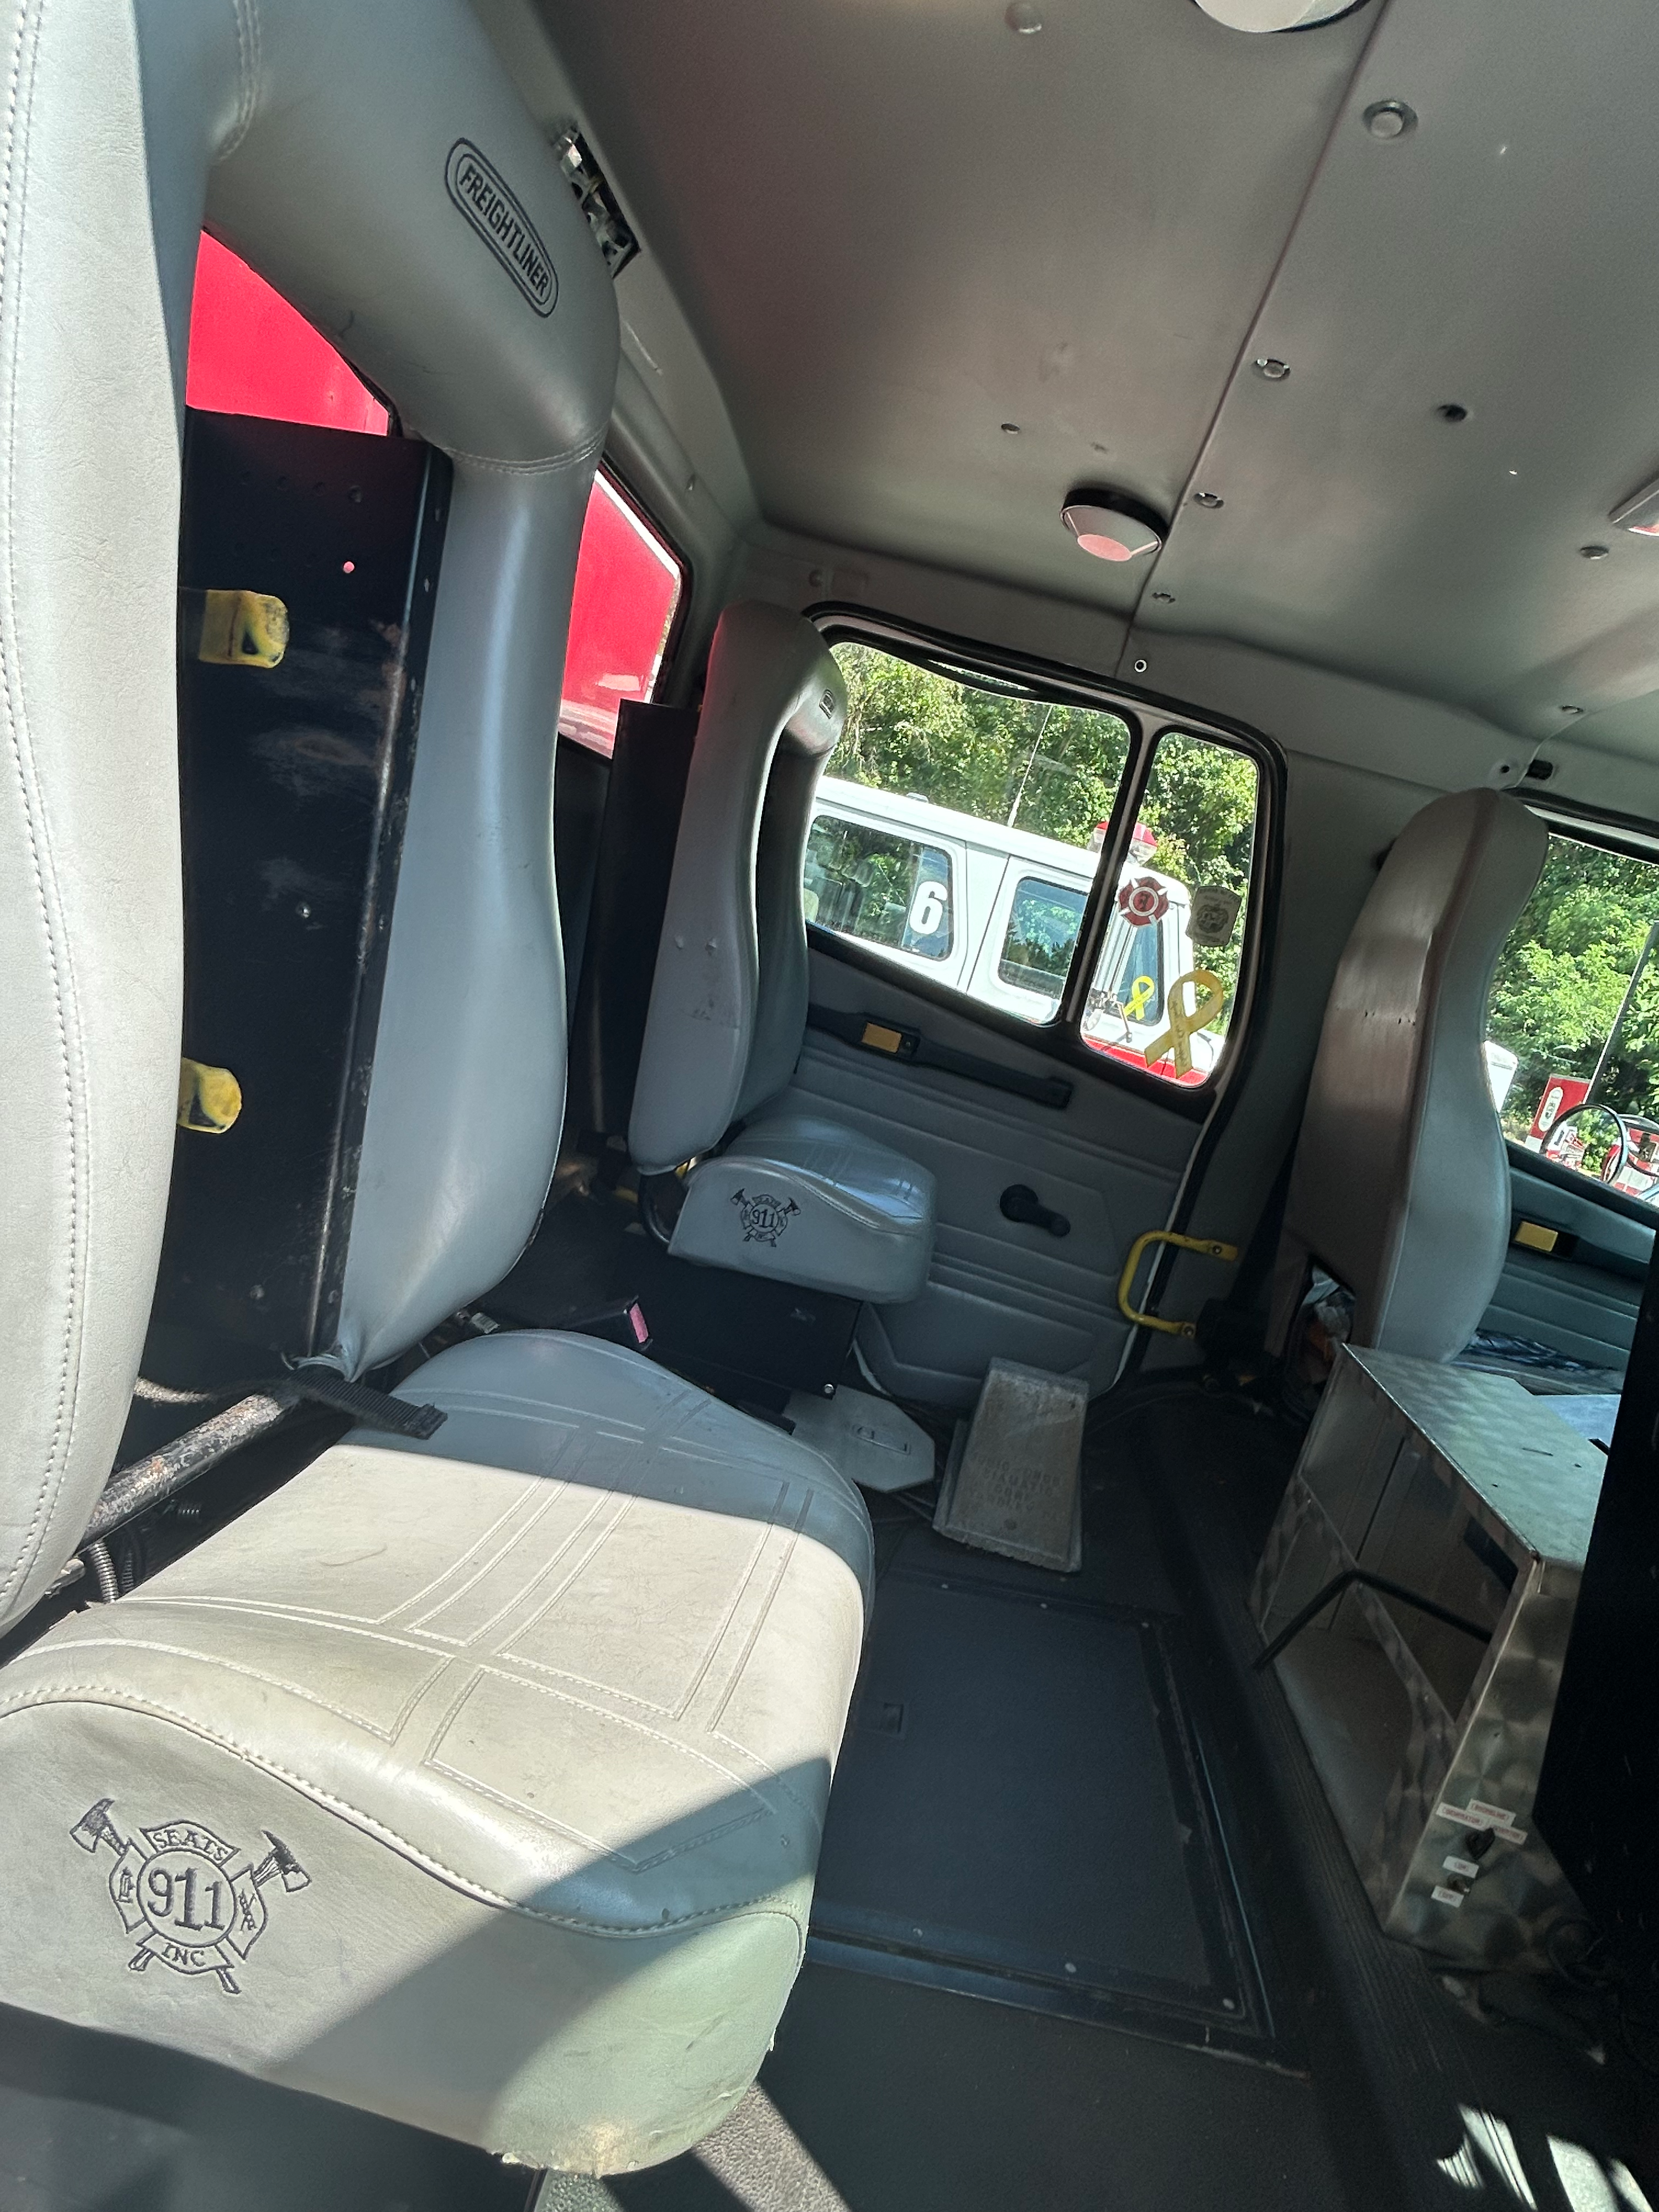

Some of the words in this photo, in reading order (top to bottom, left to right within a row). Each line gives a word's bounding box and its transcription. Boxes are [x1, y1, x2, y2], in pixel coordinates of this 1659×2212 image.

[458, 164, 549, 297] FREIGHTLINER
[909, 881, 948, 935] 6
[752, 1209, 775, 1228] 911
[153, 1829, 228, 1861] SEATS
[147, 1867, 225, 1931] 911
[162, 1942, 206, 1966] INC
